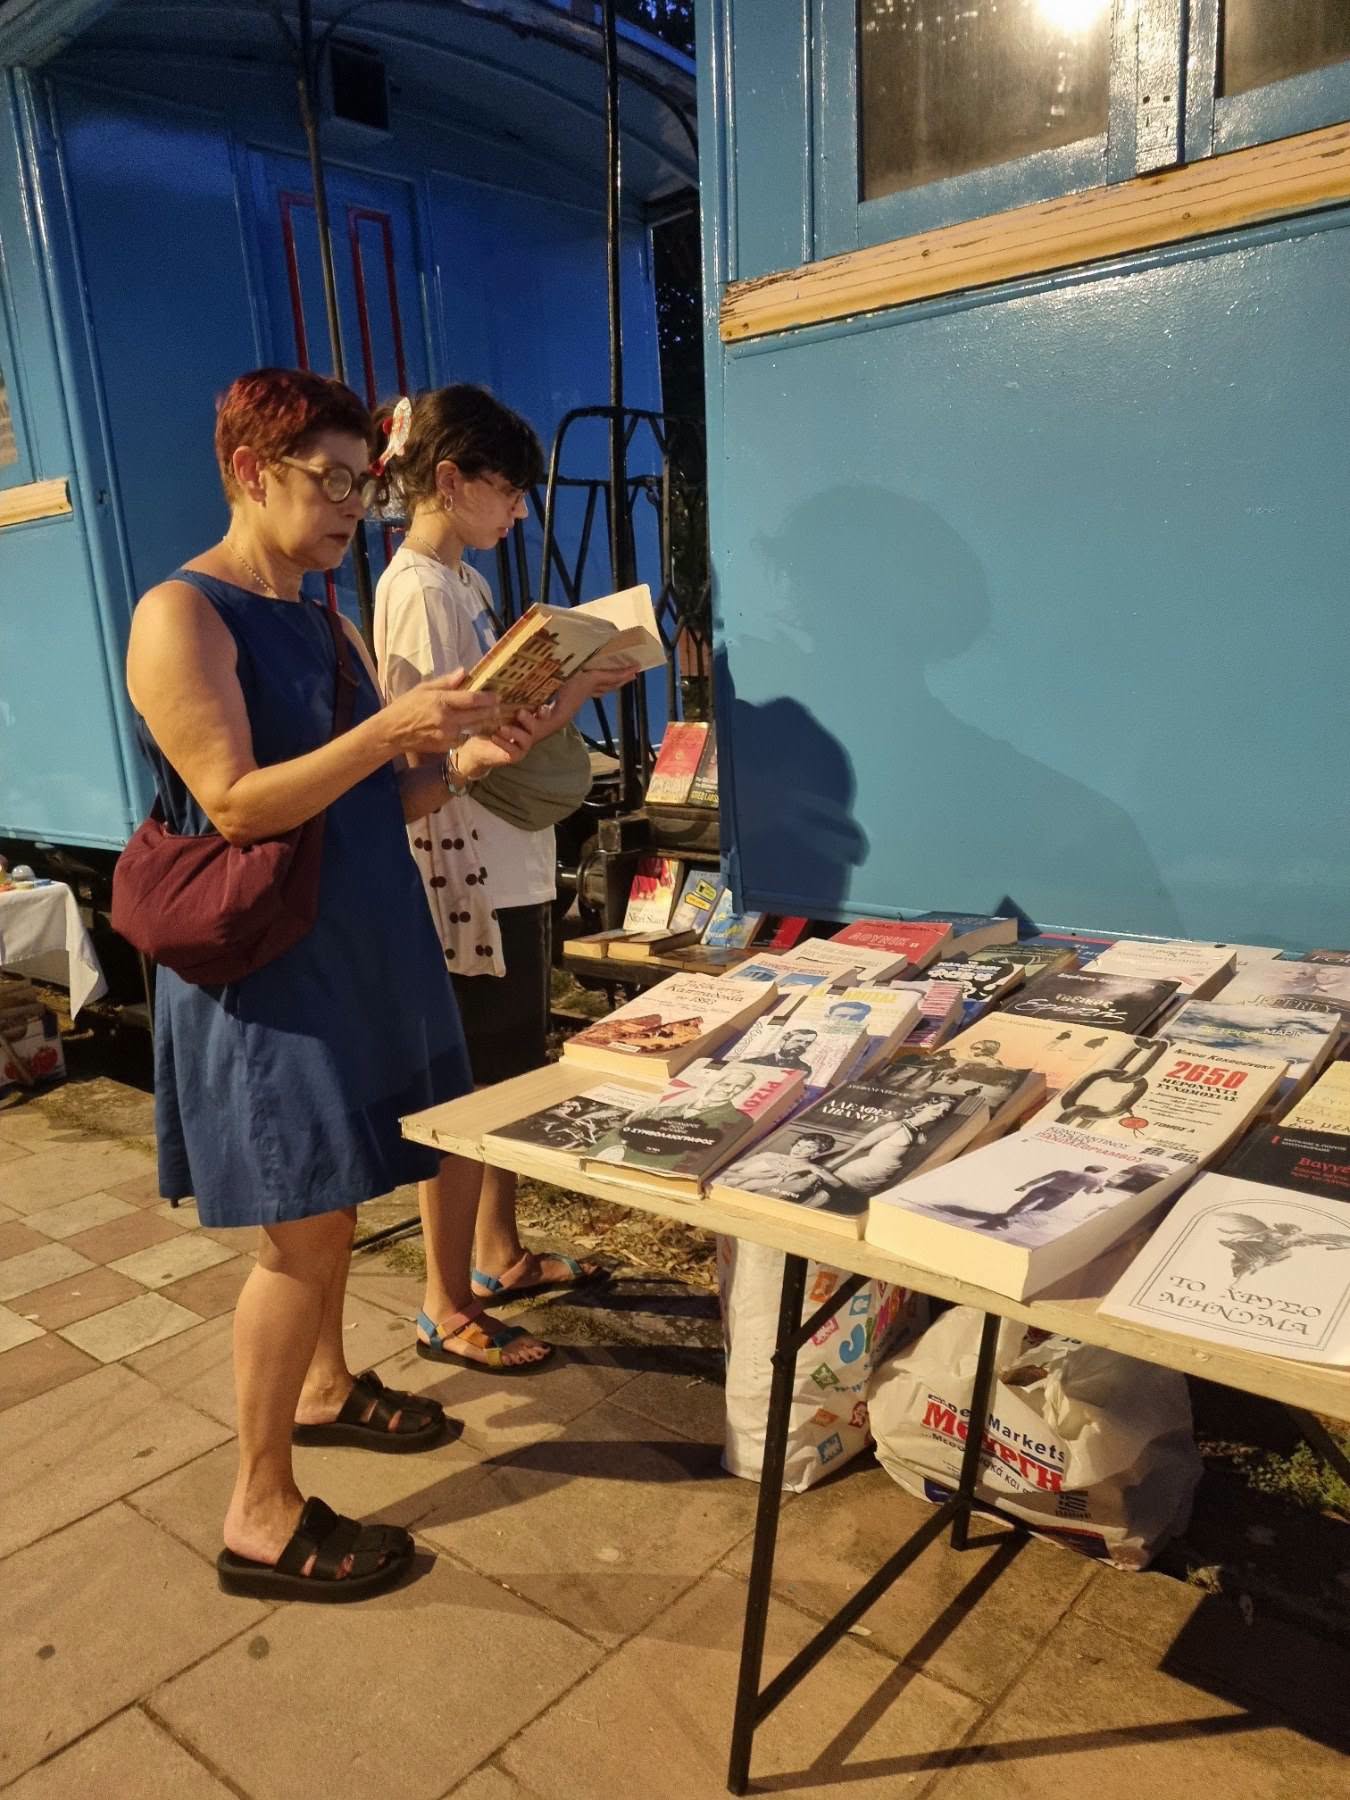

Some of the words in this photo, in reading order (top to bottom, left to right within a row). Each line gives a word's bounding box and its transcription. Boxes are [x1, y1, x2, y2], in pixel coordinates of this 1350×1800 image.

[1166, 1060, 1249, 1089] 2650
[1159, 1291, 1310, 1336] ΜΗΝΥΜΑ
[1169, 1275, 1206, 1292] ΤΟ
[1220, 1287, 1322, 1319] ΧΡΥΣΟ
[987, 1413, 1065, 1464] Markets
[1004, 1473, 1020, 1490] και
